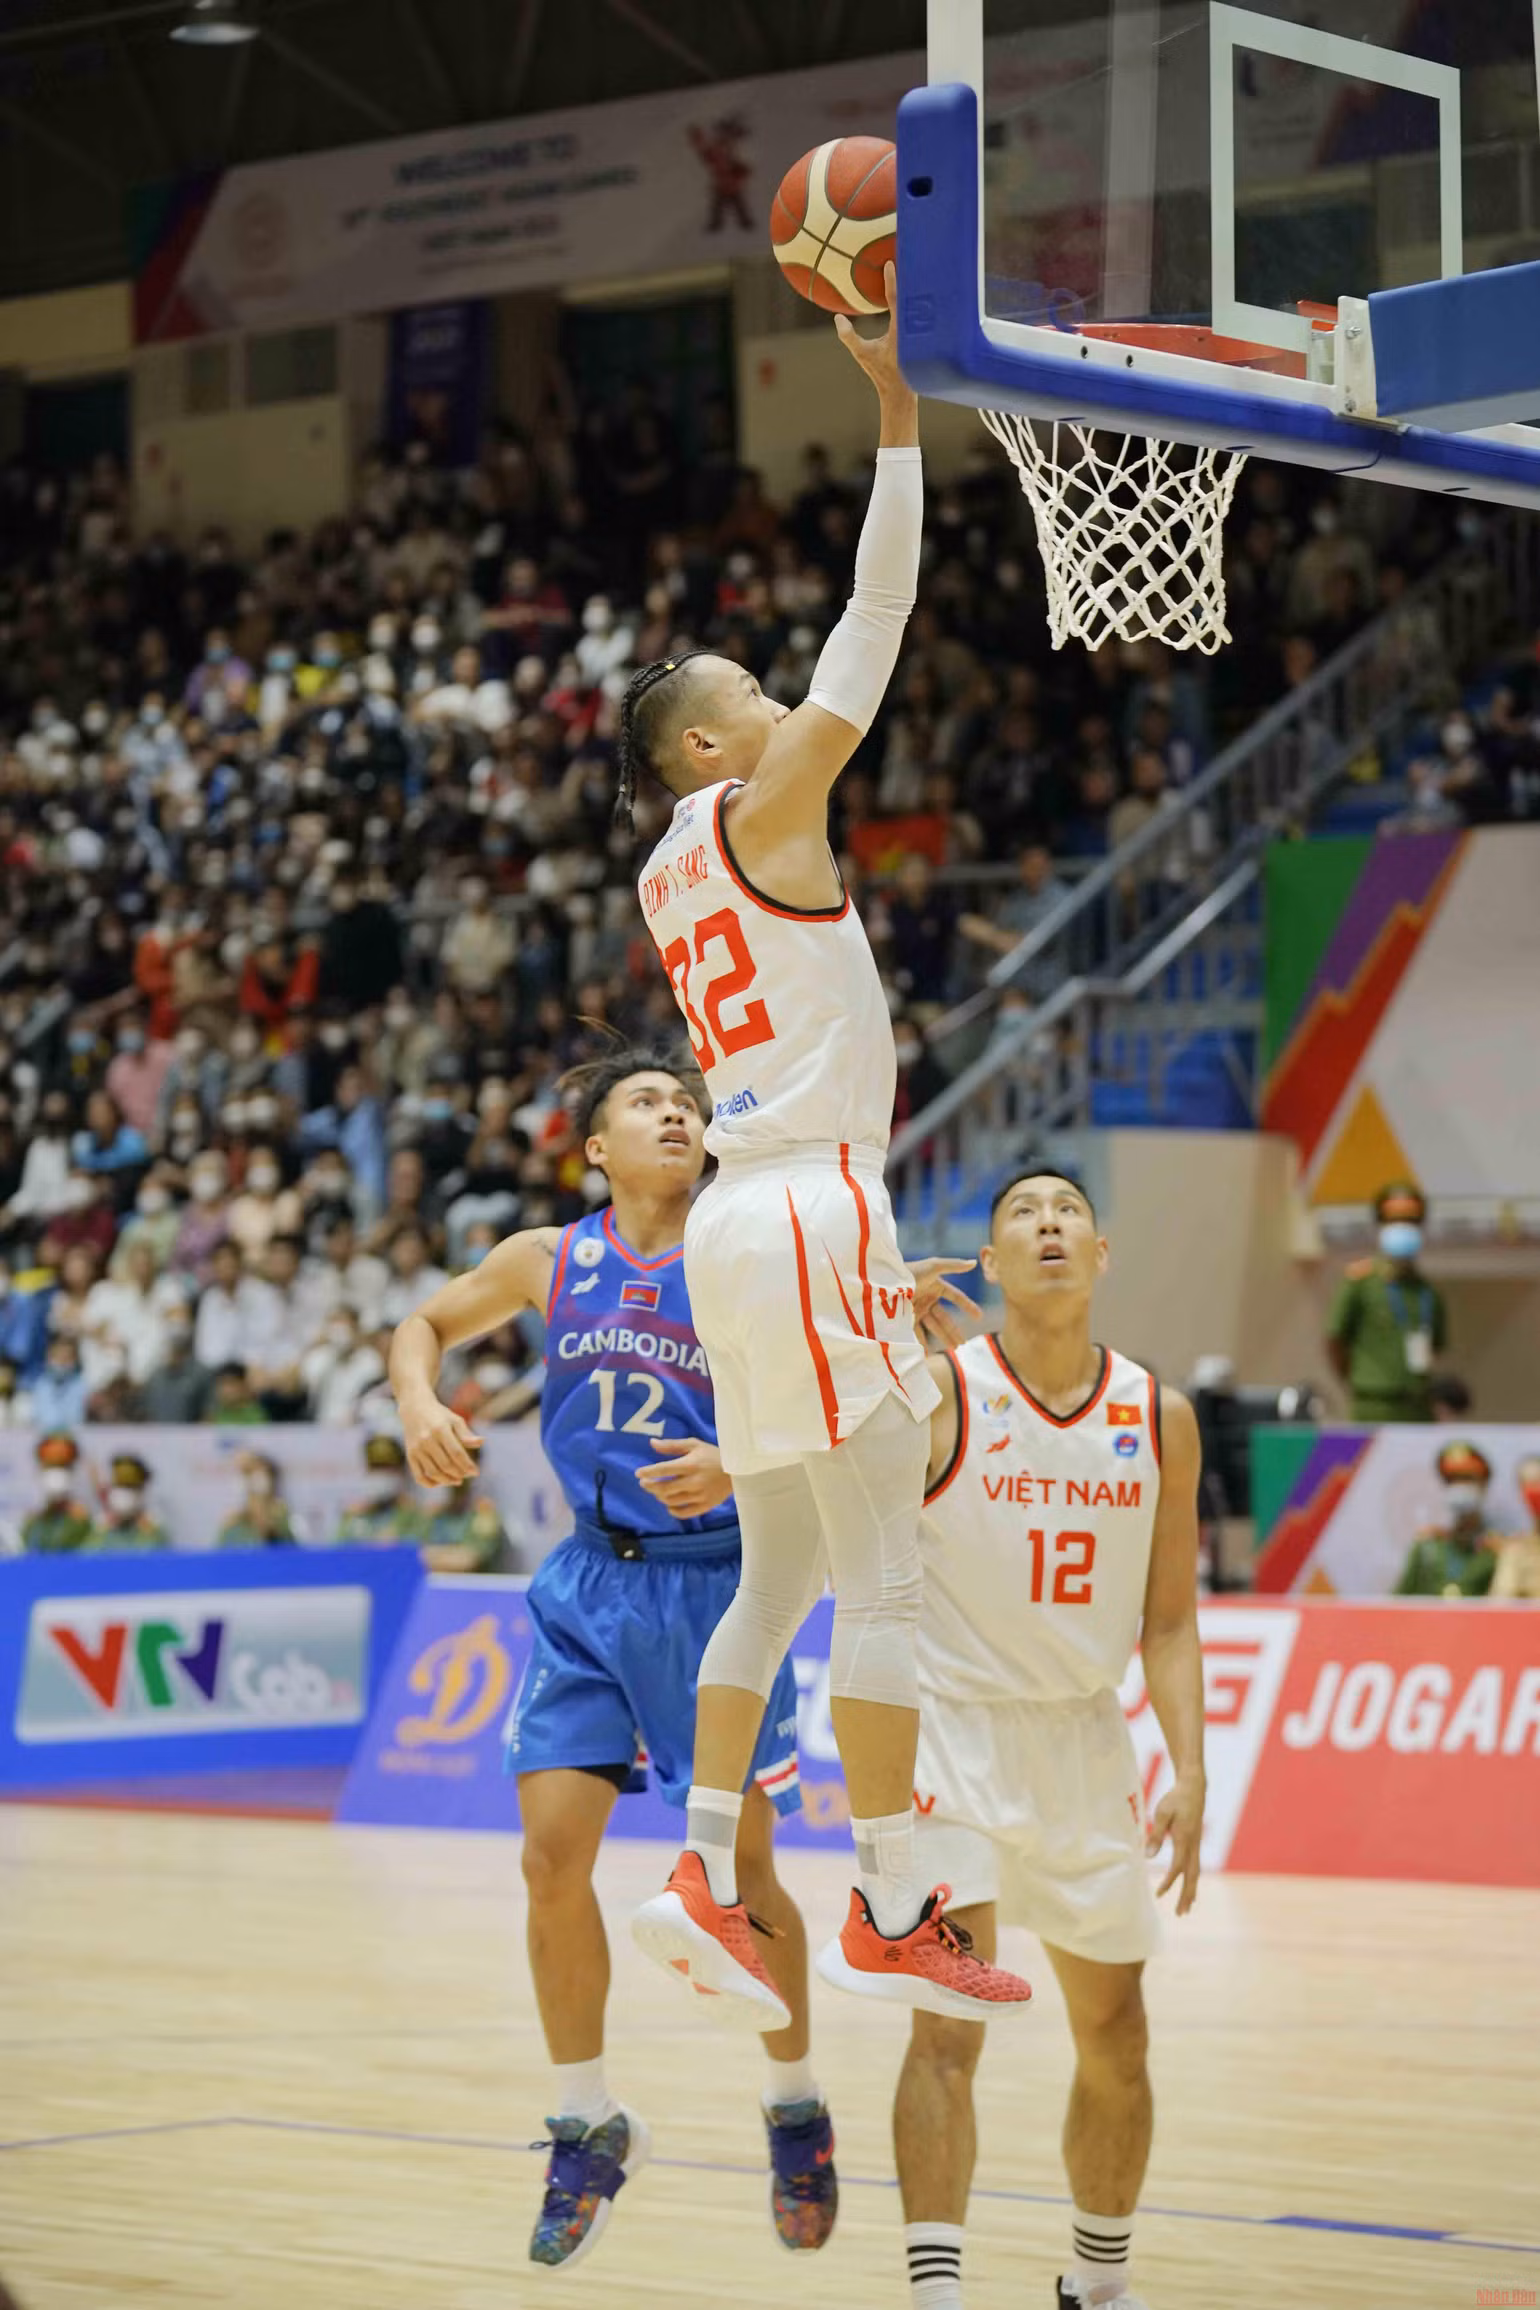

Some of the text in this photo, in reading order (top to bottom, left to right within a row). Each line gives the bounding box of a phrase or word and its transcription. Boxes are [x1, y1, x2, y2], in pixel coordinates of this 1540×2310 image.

[663, 907, 776, 1074] 32
[558, 1328, 709, 1377] CAMBODIA
[588, 1368, 666, 1438] 12
[982, 1469, 1141, 1509] VIỆT NAM
[1027, 1528, 1096, 1604] 12
